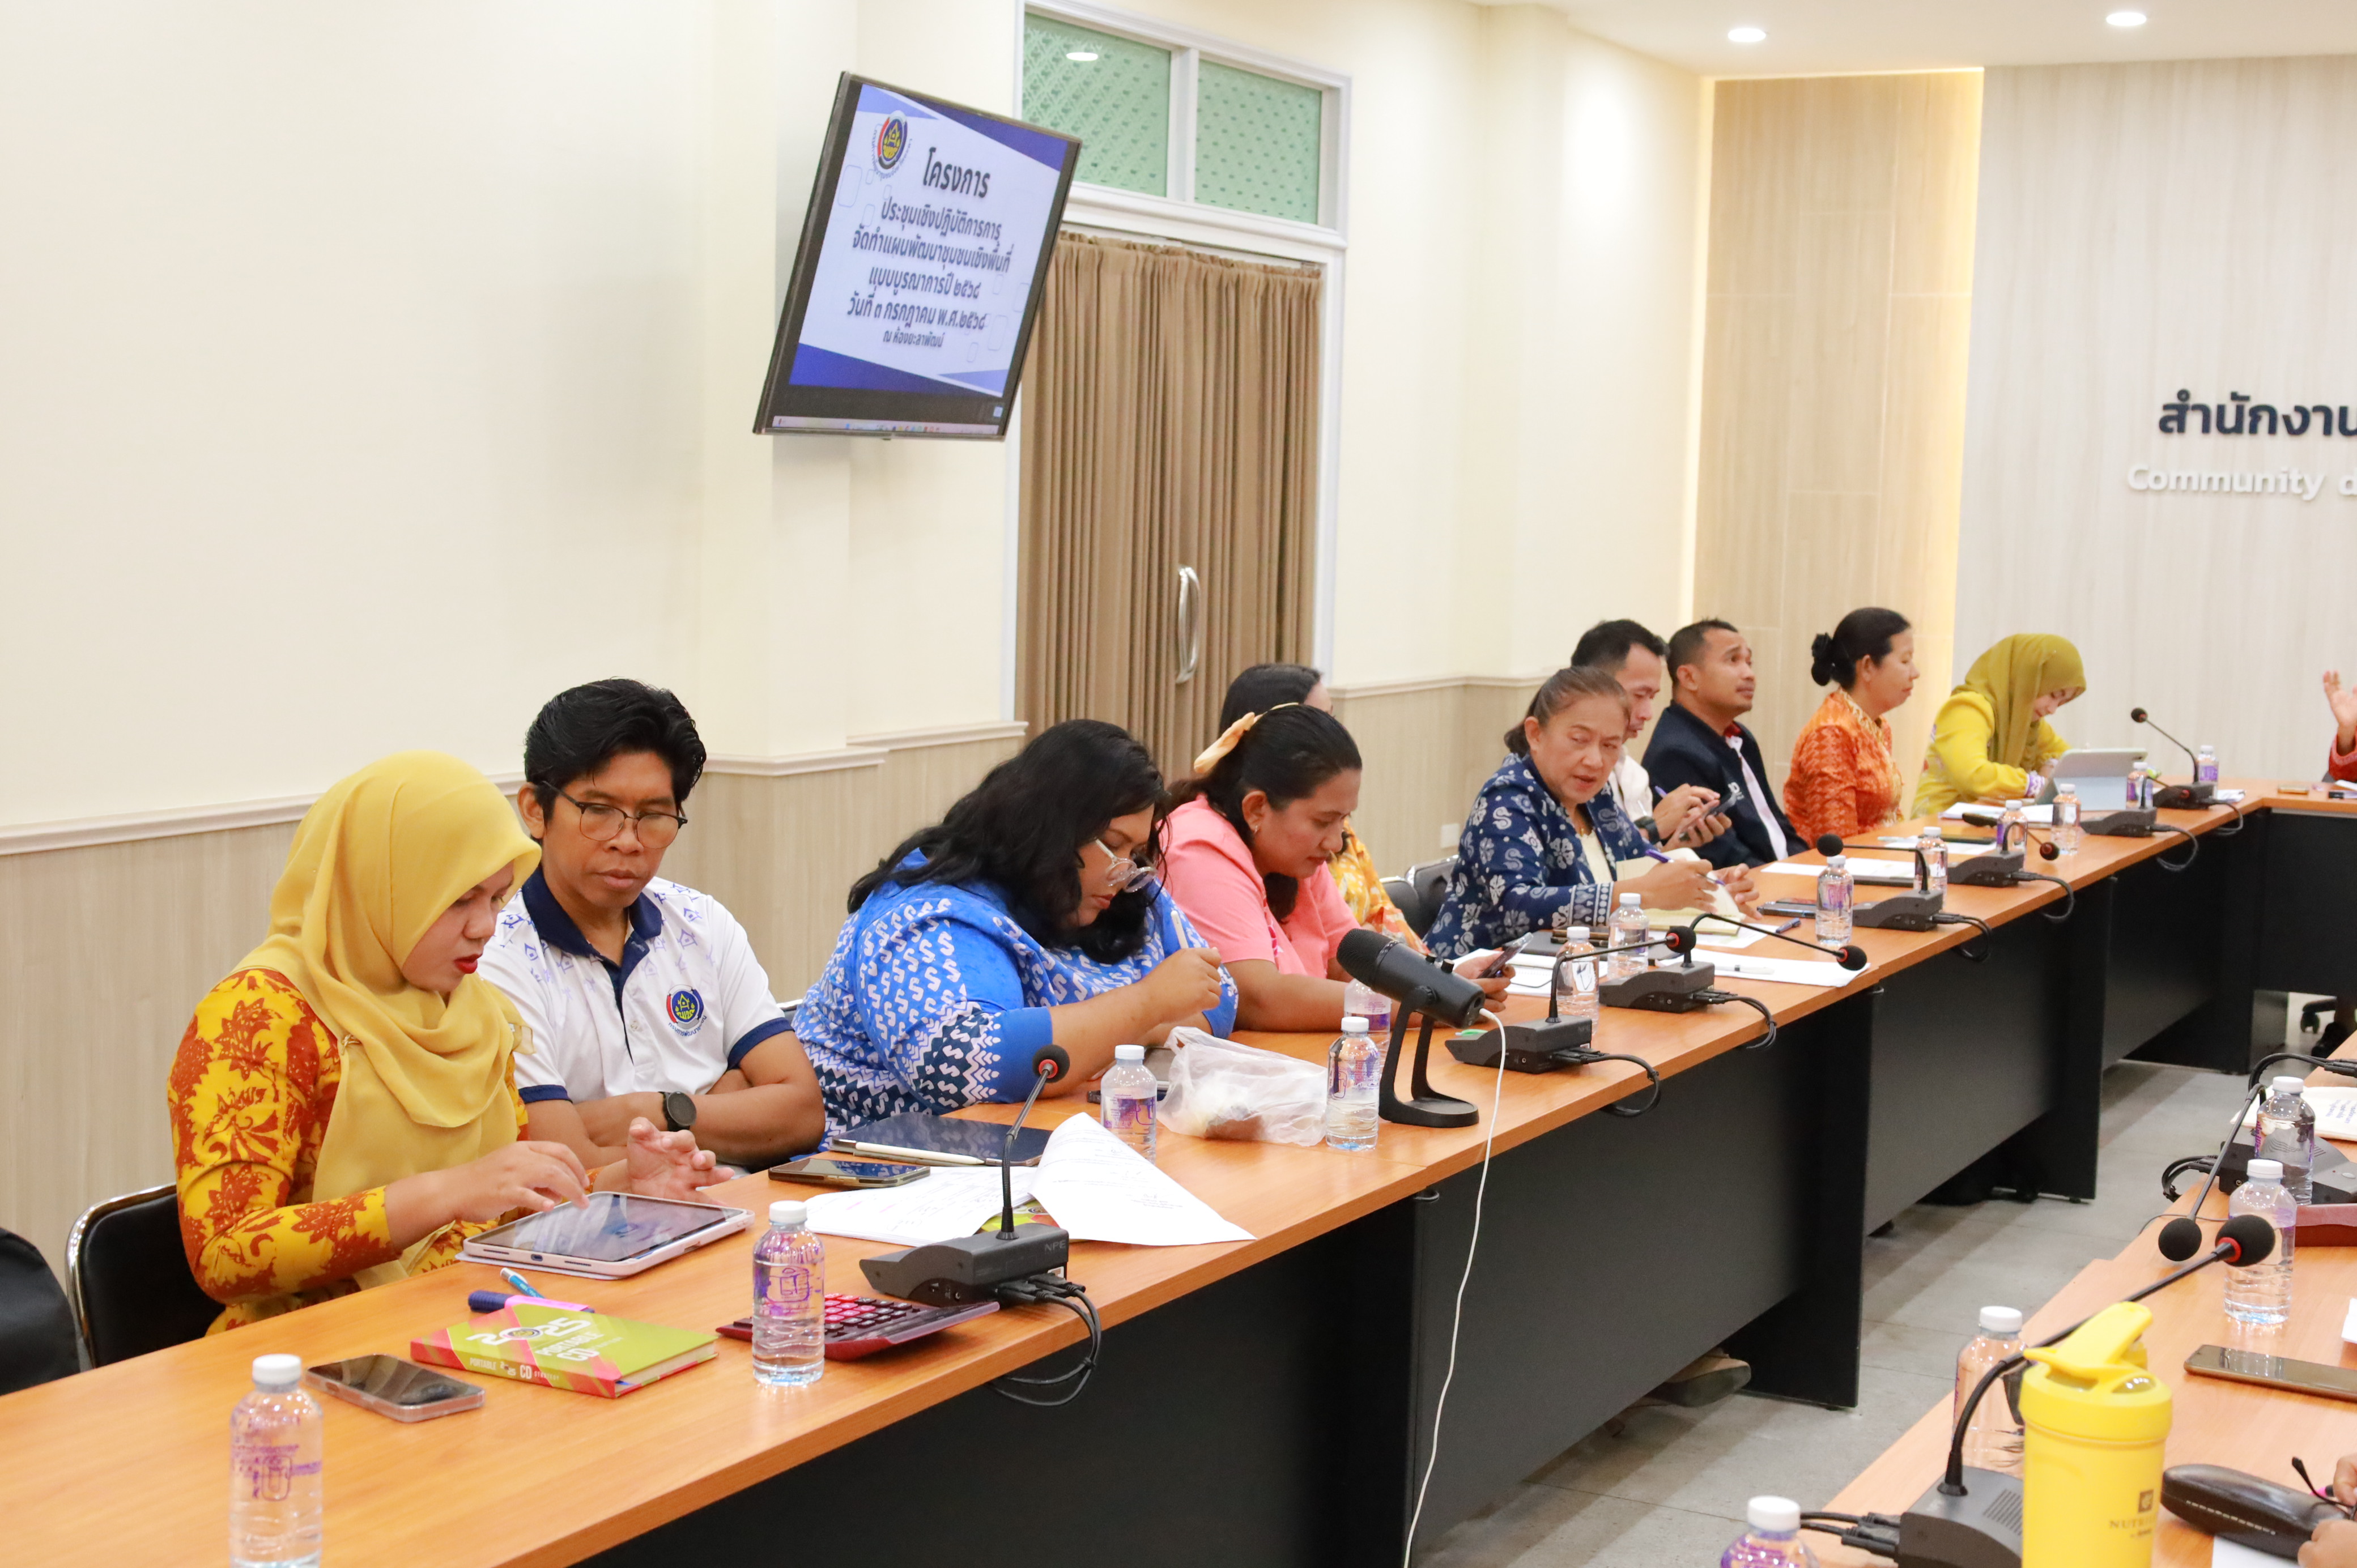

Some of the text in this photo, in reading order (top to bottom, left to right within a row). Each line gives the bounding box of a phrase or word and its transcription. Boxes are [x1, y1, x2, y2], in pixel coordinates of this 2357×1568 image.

[922, 147, 990, 198] โครงการ
[846, 287, 875, 318] วันที่
[883, 301, 937, 329] กรกฎาคม
[2127, 463, 2325, 501] Community
[1045, 1241, 1066, 1251] NPE
[534, 1331, 605, 1356] PORTABLE
[556, 1348, 600, 1362] CD
[469, 1357, 496, 1370] PORTABLE
[520, 1364, 533, 1380] CD
